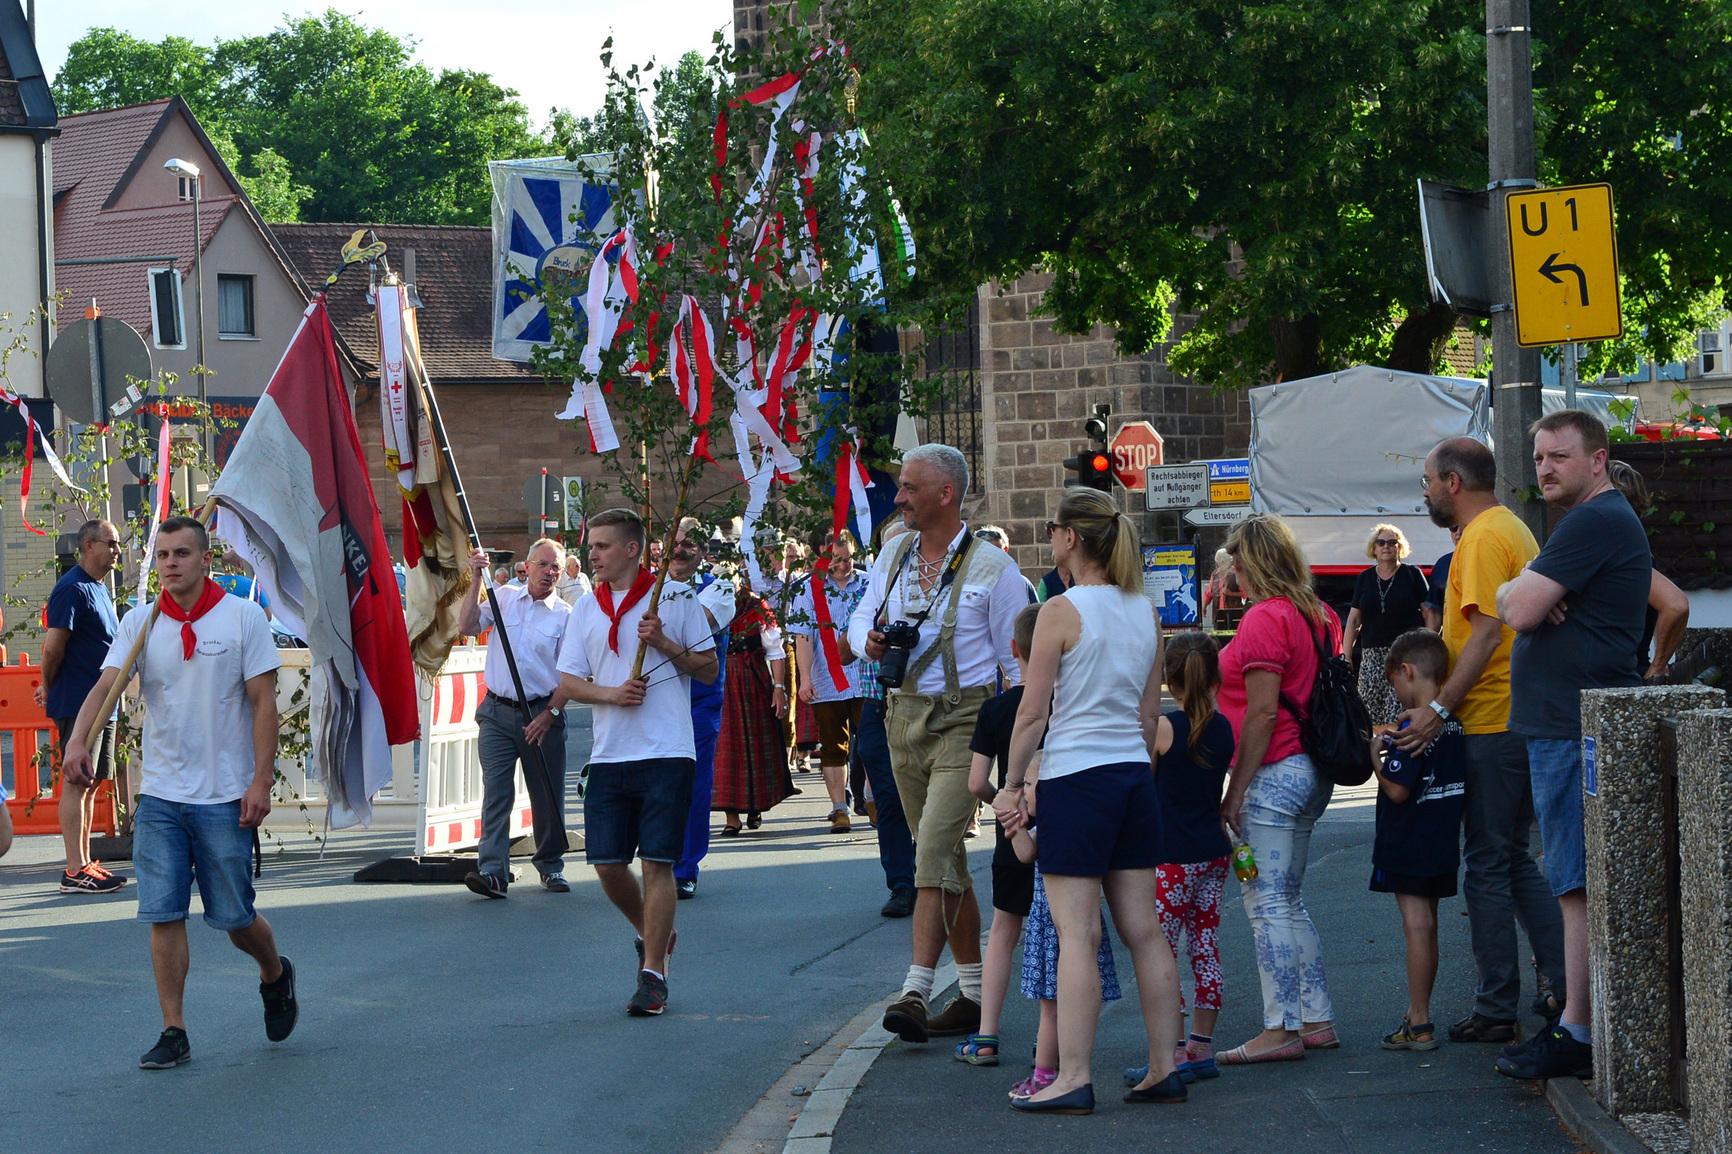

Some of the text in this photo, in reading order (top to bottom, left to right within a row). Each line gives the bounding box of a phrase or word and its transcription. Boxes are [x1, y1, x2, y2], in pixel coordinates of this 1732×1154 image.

[1520, 197, 1579, 236] U 1
[1114, 443, 1157, 472] STOP
[1221, 464, 1249, 474] Nürnberg
[1151, 471, 1203, 481] Rechtsabbieger
[1153, 484, 1165, 492] auf
[1224, 488, 1233, 497] 14
[1167, 496, 1191, 504] achten
[1203, 511, 1242, 520] Eltersdorf
